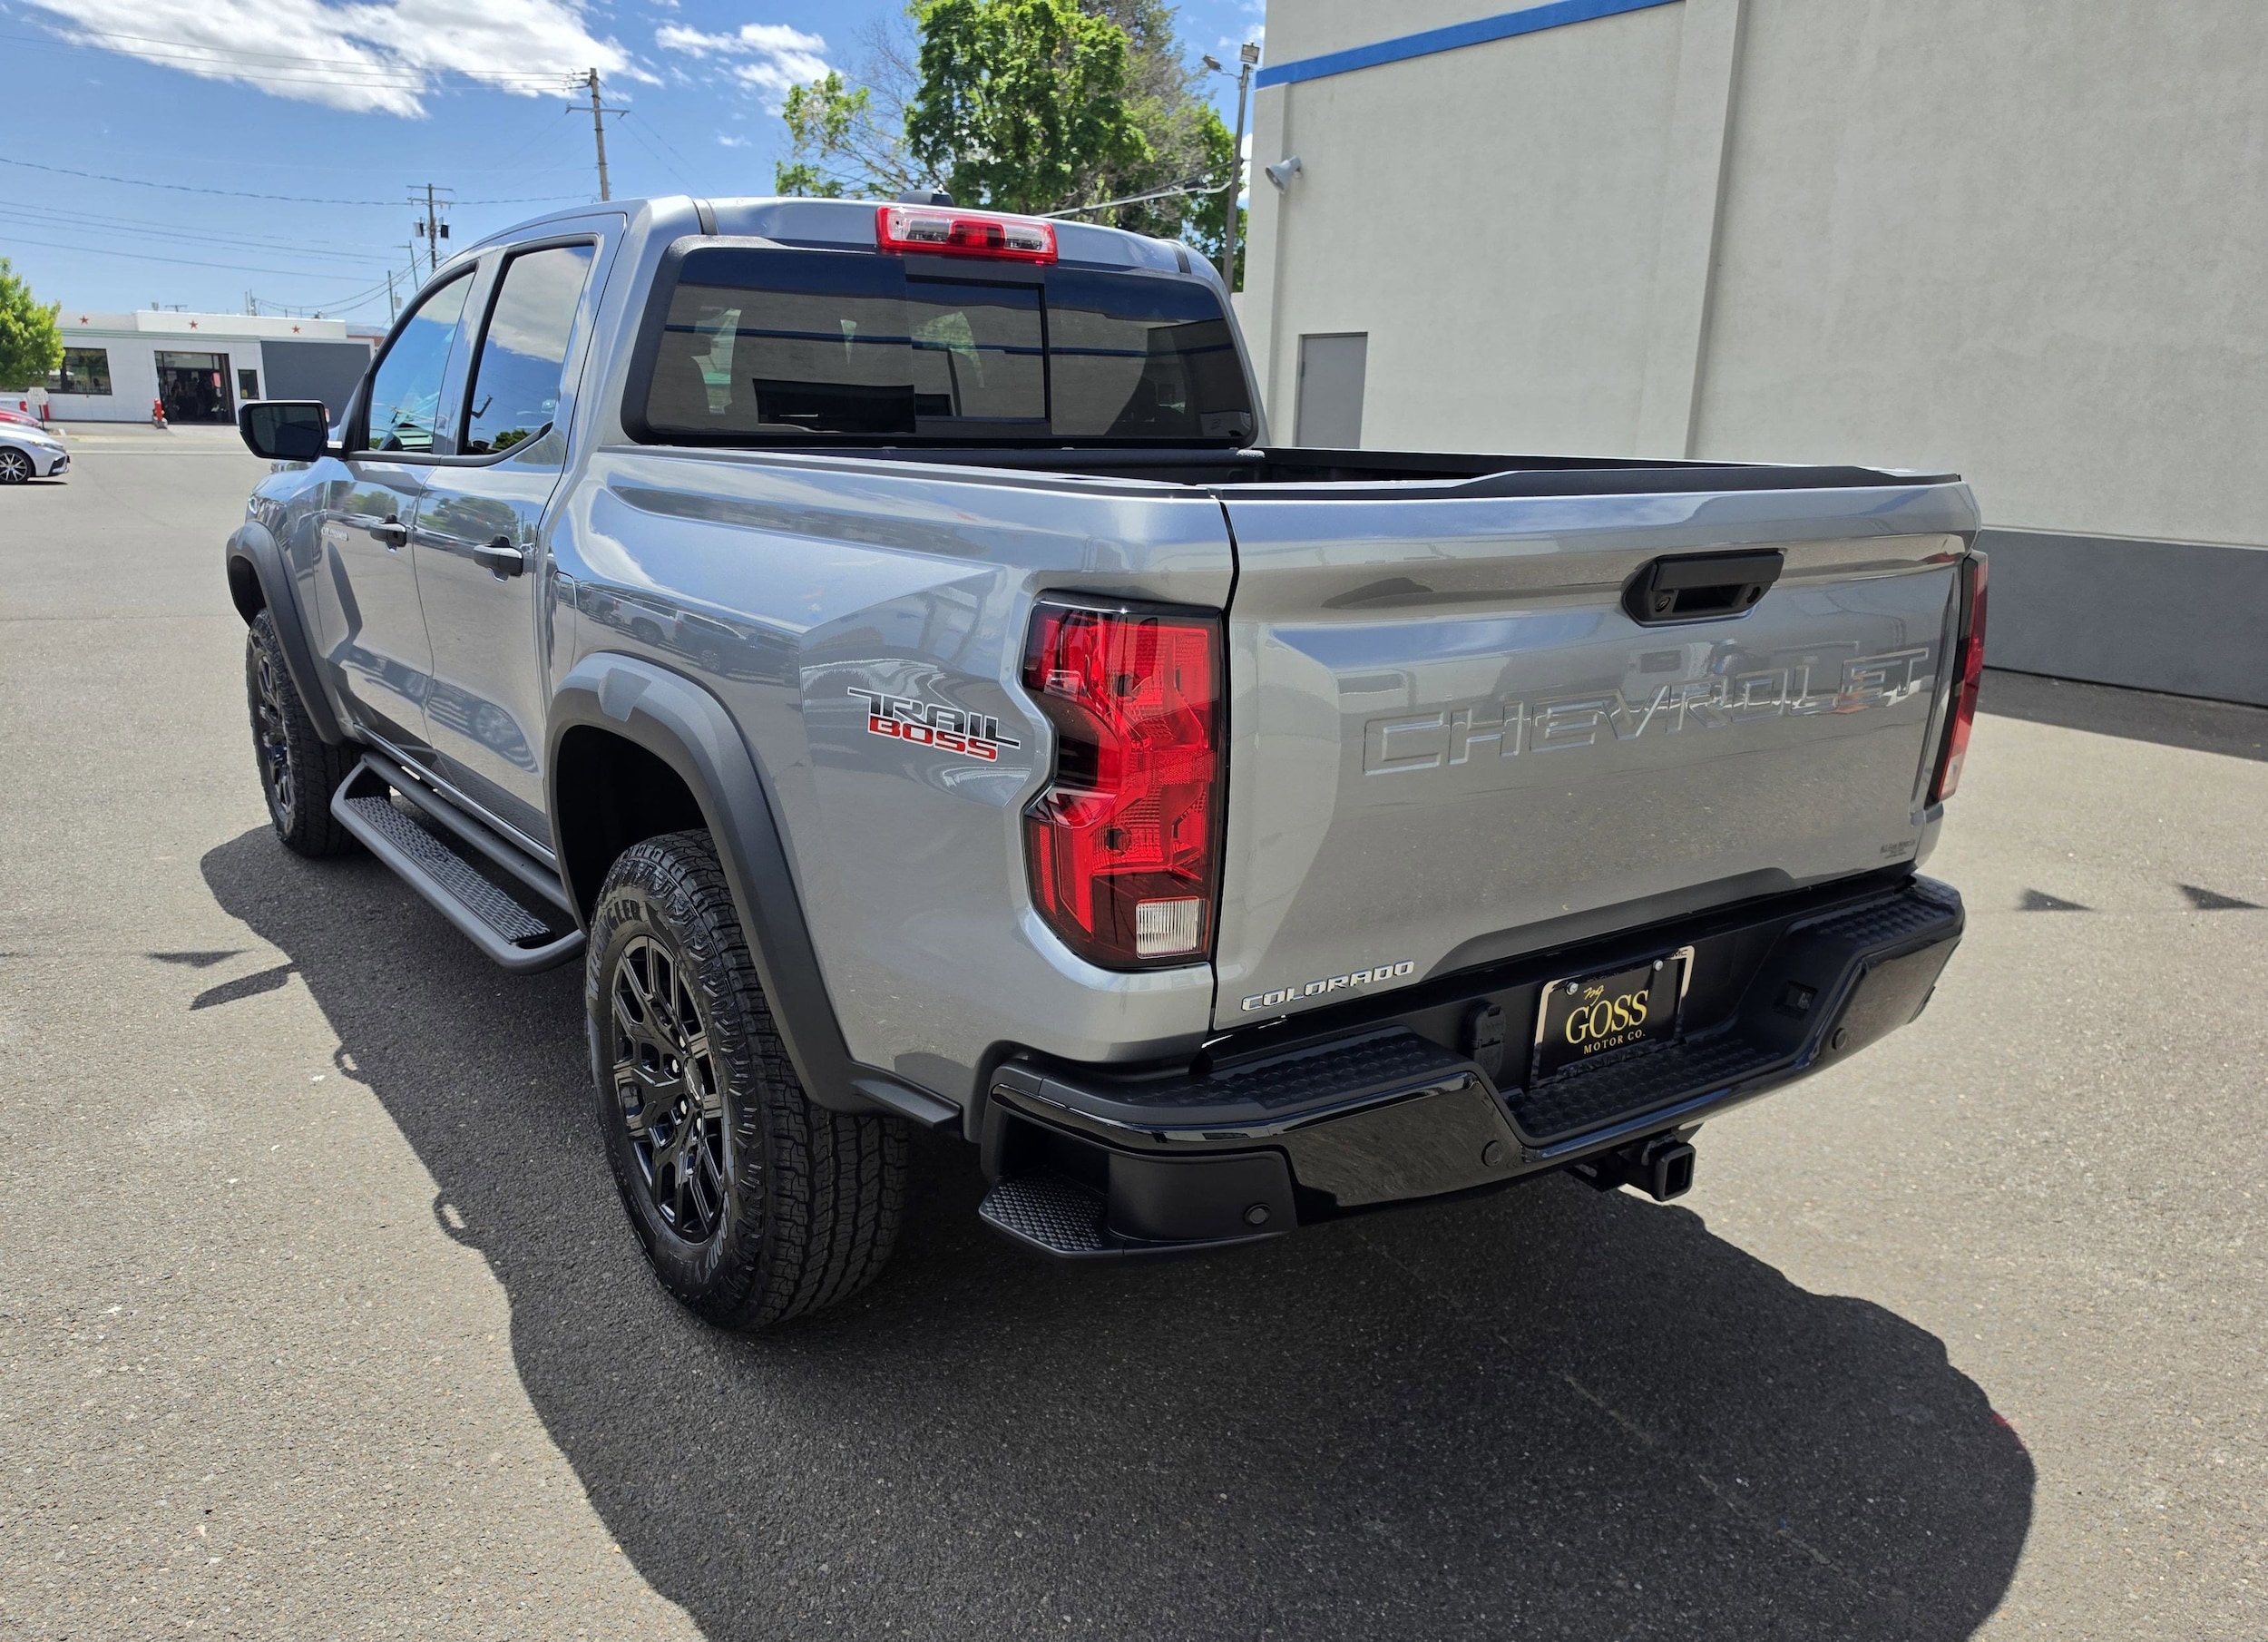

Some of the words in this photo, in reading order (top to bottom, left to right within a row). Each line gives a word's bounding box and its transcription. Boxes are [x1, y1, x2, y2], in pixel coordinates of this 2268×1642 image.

[847, 687, 1021, 749] TRAIL
[867, 715, 997, 762] BOSS
[1363, 648, 1929, 776] CHEVROLET
[1241, 959, 1415, 1012] COLORADO
[1565, 990, 1649, 1044] GOSS
[1583, 1032, 1624, 1055] MOTOR
[1628, 1029, 1647, 1041] CO.
